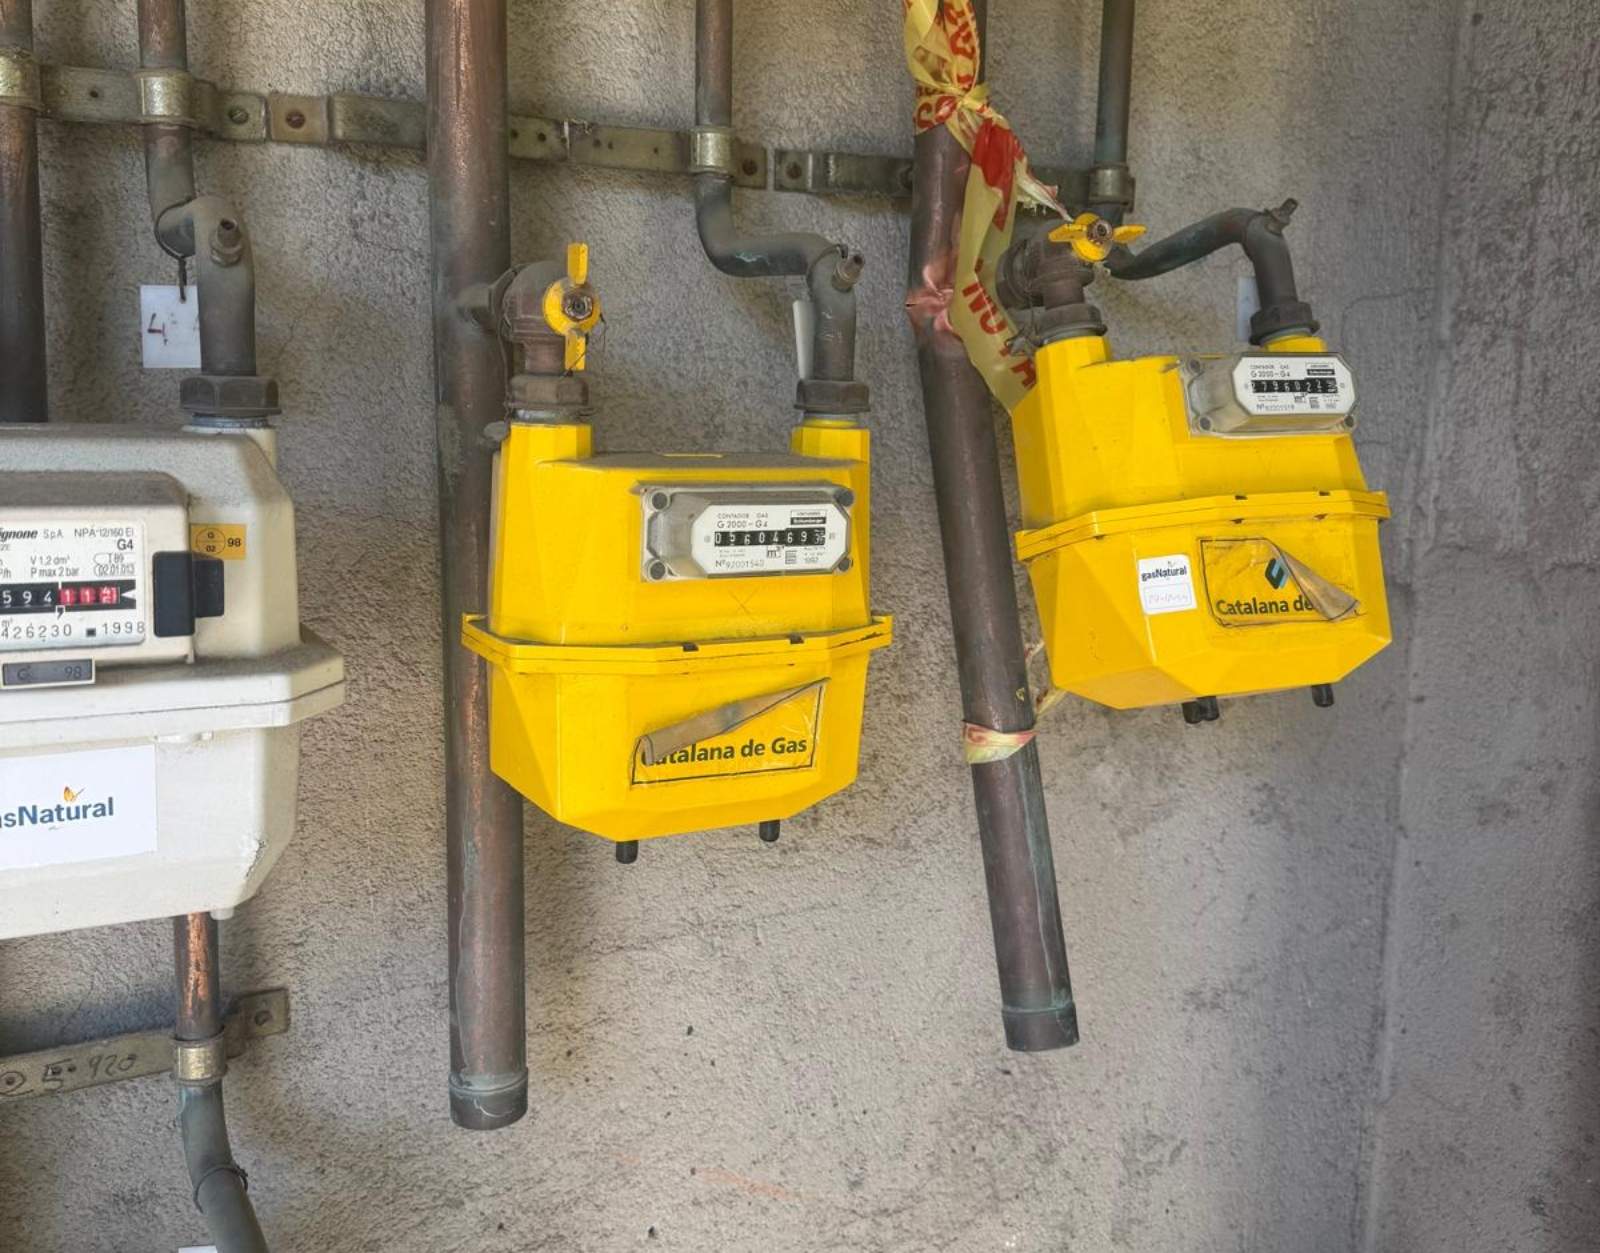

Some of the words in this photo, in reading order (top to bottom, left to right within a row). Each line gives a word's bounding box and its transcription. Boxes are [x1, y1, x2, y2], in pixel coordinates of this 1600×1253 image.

[116, 539, 134, 551] G4
[227, 537, 242, 548] 98
[30, 554, 38, 566] V
[30, 567, 38, 578] P
[39, 568, 58, 577] max
[58, 566, 65, 577] 2
[66, 567, 81, 577] bar
[1141, 565, 1188, 582] gasNatural
[1216, 596, 1289, 616] Catalana
[101, 620, 146, 635] 1998
[63, 665, 83, 681] 98
[740, 738, 766, 756] de
[771, 736, 808, 754] Gas
[0, 796, 114, 829] sNatural
